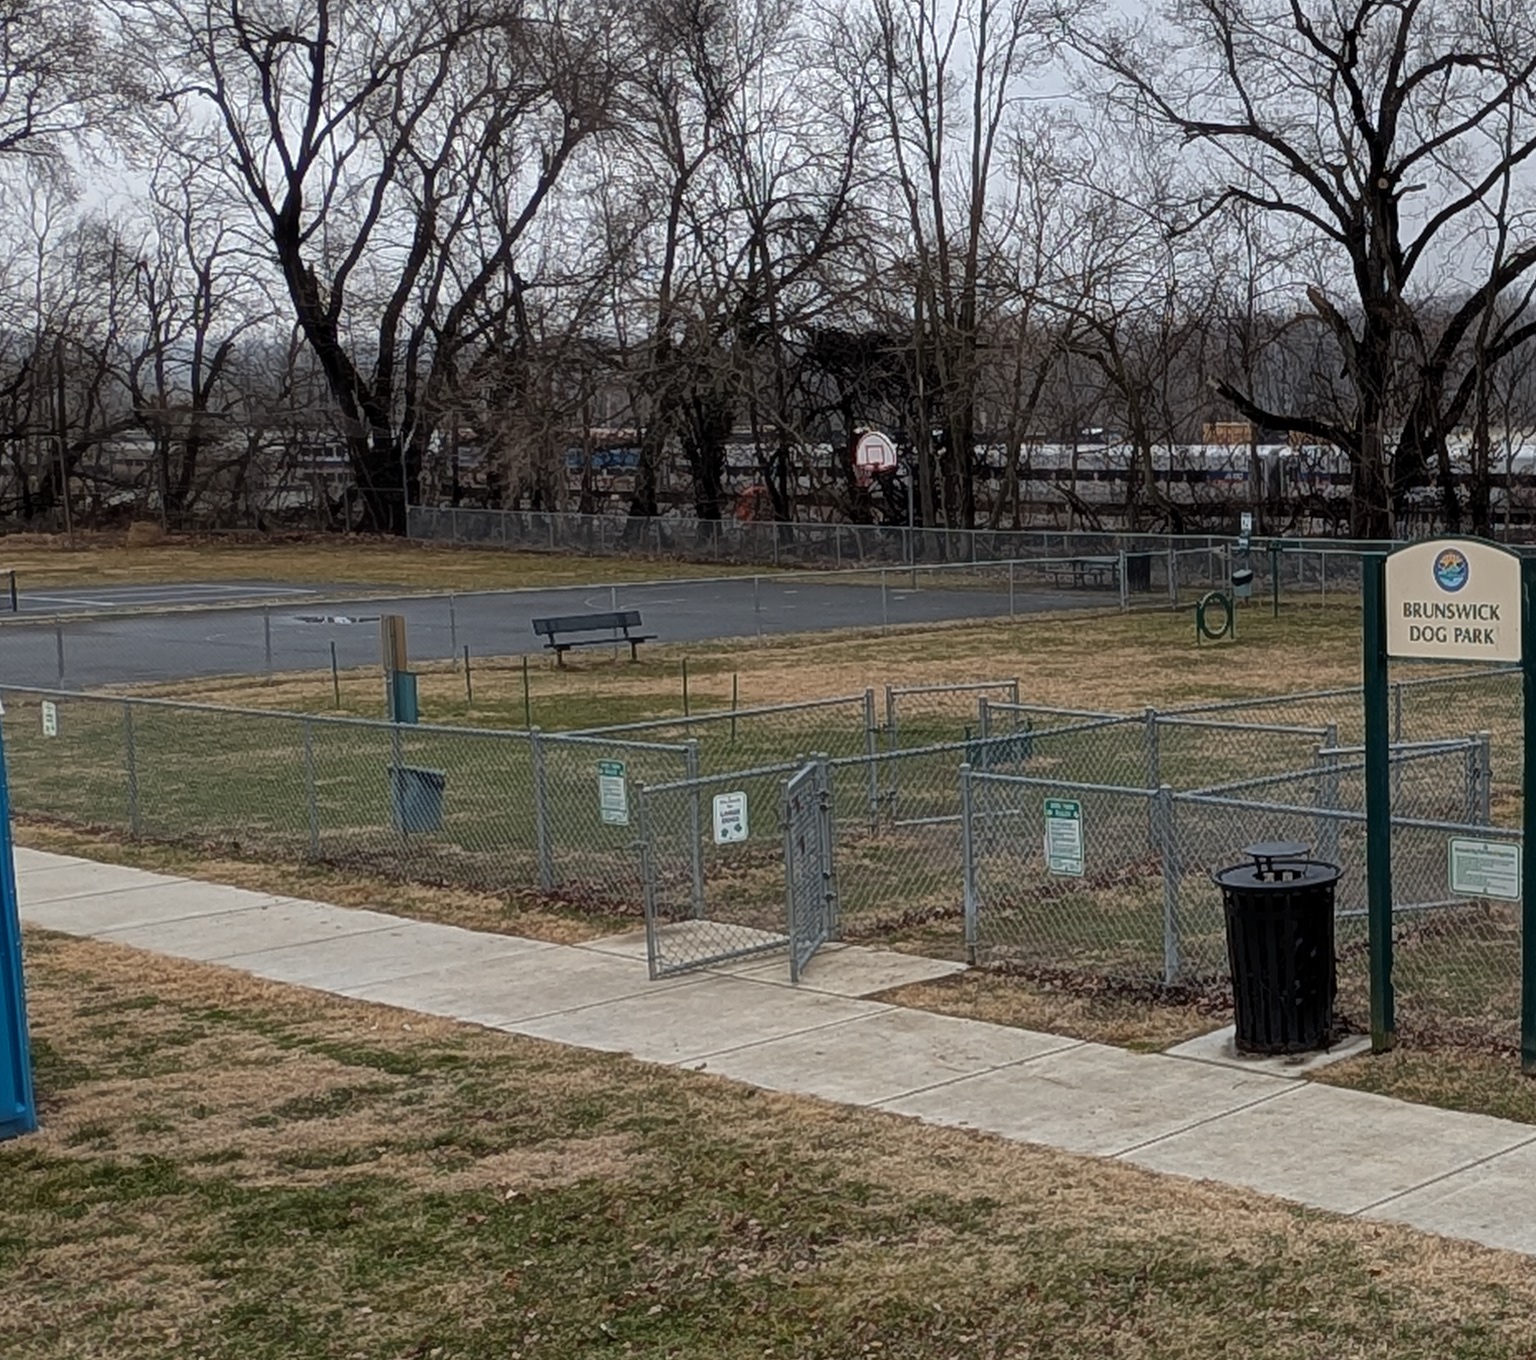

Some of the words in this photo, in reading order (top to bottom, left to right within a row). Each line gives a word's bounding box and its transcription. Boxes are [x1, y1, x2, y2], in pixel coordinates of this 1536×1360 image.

[1403, 602, 1500, 621] BRUNSWICK
[1410, 625, 1447, 643] DOG
[1454, 627, 1494, 644] PARK
